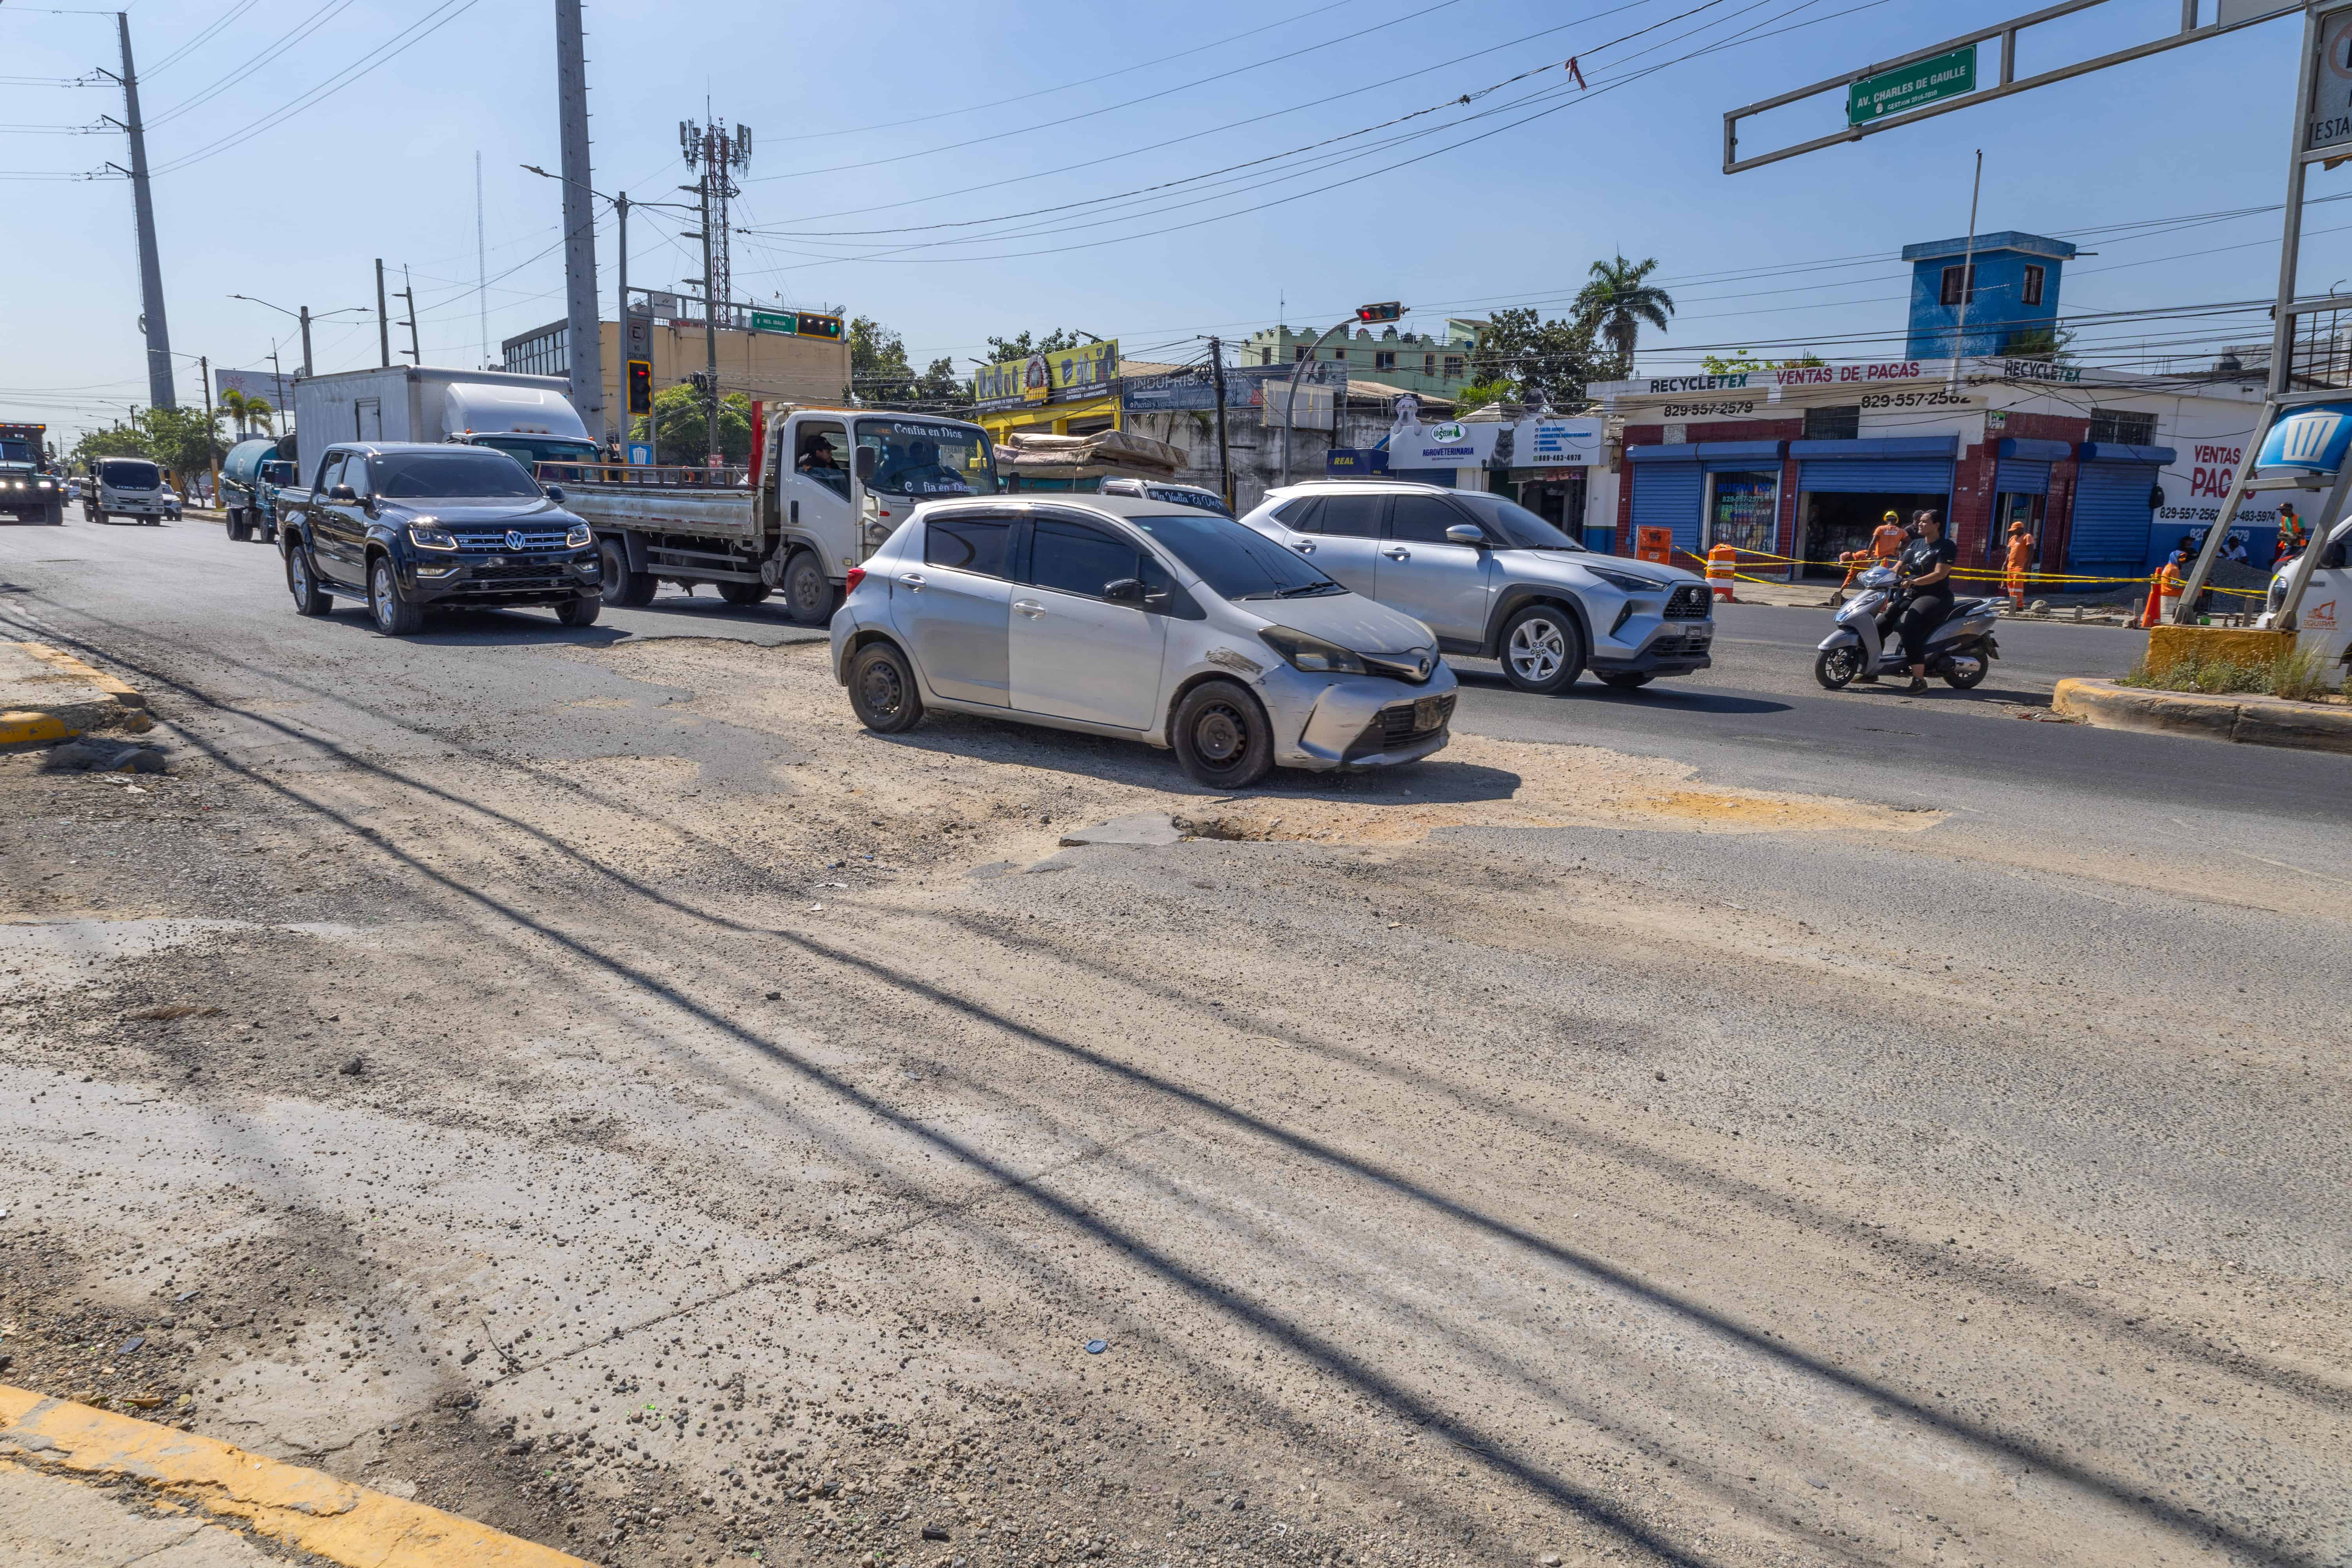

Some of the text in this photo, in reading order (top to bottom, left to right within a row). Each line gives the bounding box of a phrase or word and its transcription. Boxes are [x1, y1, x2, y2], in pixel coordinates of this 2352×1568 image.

[1857, 65, 1966, 108] AV. CHARLES DE GAULLE
[1887, 98, 1910, 111] GESTION
[2314, 116, 2352, 141] ESTA
[1777, 362, 1920, 385] VENTAS DE PACAS
[2004, 359, 2082, 383] RECYCLETEX
[1650, 373, 1748, 393] RECYCLETEX
[1664, 401, 1753, 417] 829-557-2579
[894, 423, 926, 436] Confia
[941, 427, 963, 439] Dios
[1422, 447, 1474, 457] AGROVETERINARIA
[2194, 445, 2241, 465] VENTAS
[952, 482, 972, 493] Dios
[1717, 483, 1754, 492] BUENA
[1165, 492, 1189, 503] Vuelta
